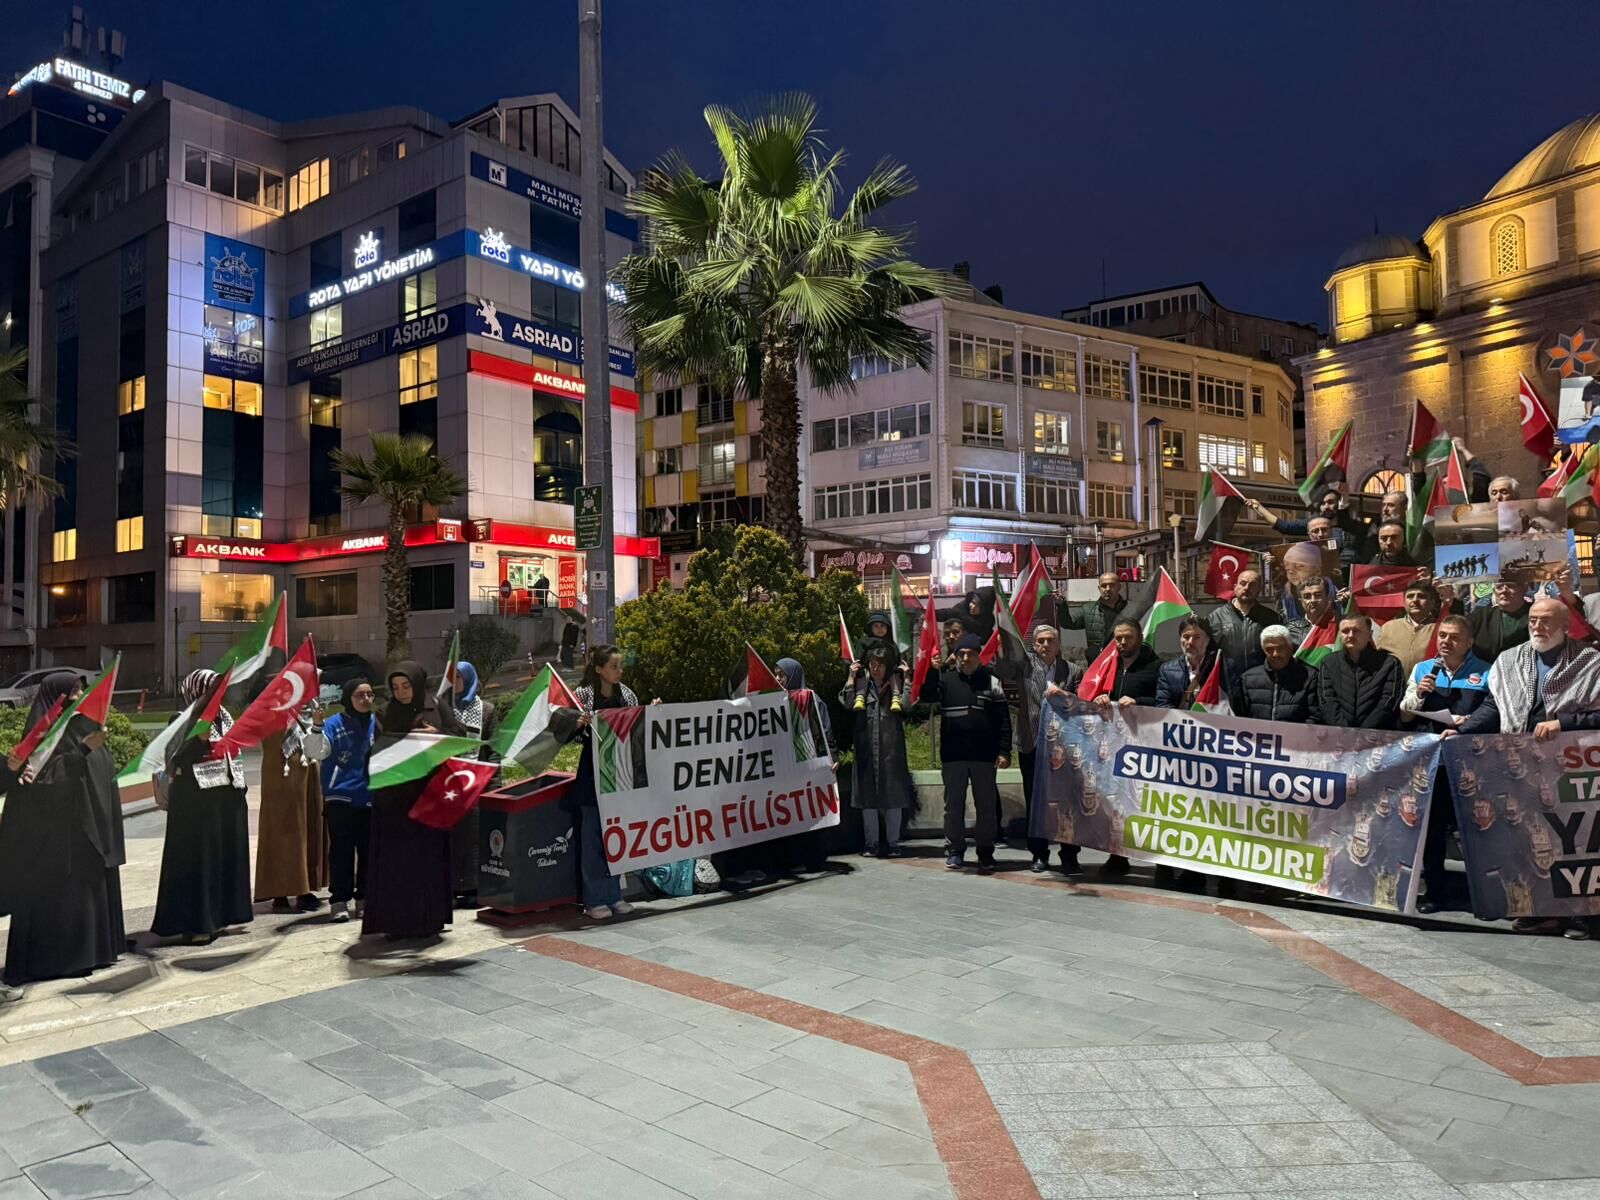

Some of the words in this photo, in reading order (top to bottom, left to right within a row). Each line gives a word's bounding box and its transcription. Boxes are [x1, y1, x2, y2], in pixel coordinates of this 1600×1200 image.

[55, 58, 91, 84] FATİH
[92, 71, 131, 97] TEMİZ
[527, 188, 539, 198] M.
[542, 194, 570, 211] FATİH
[531, 180, 556, 196] MALİ
[357, 253, 375, 266] rota
[482, 245, 508, 260] rota
[309, 284, 341, 308] ROTA
[343, 272, 373, 295] YAPI
[374, 249, 434, 283] YÖNETİM
[521, 255, 559, 281] YAPI
[320, 343, 351, 361] İNSANLARI
[313, 358, 337, 373] SAMSUN
[195, 543, 265, 557] AKBANK
[342, 536, 384, 550] AKBANK
[548, 534, 576, 546] AKB
[651, 705, 789, 751] NEHİRDEN
[1162, 720, 1291, 763] KÜRESEL
[674, 748, 775, 791] DENİZE
[1120, 750, 1219, 790] SUMUD
[1226, 762, 1335, 807] FİLOSU
[604, 804, 714, 864] ÖZGÜR
[722, 781, 839, 838] FİLİSTİN
[1140, 783, 1309, 840] İNSANLIĞIN
[1130, 820, 1315, 882] VİCDANIDIR!
